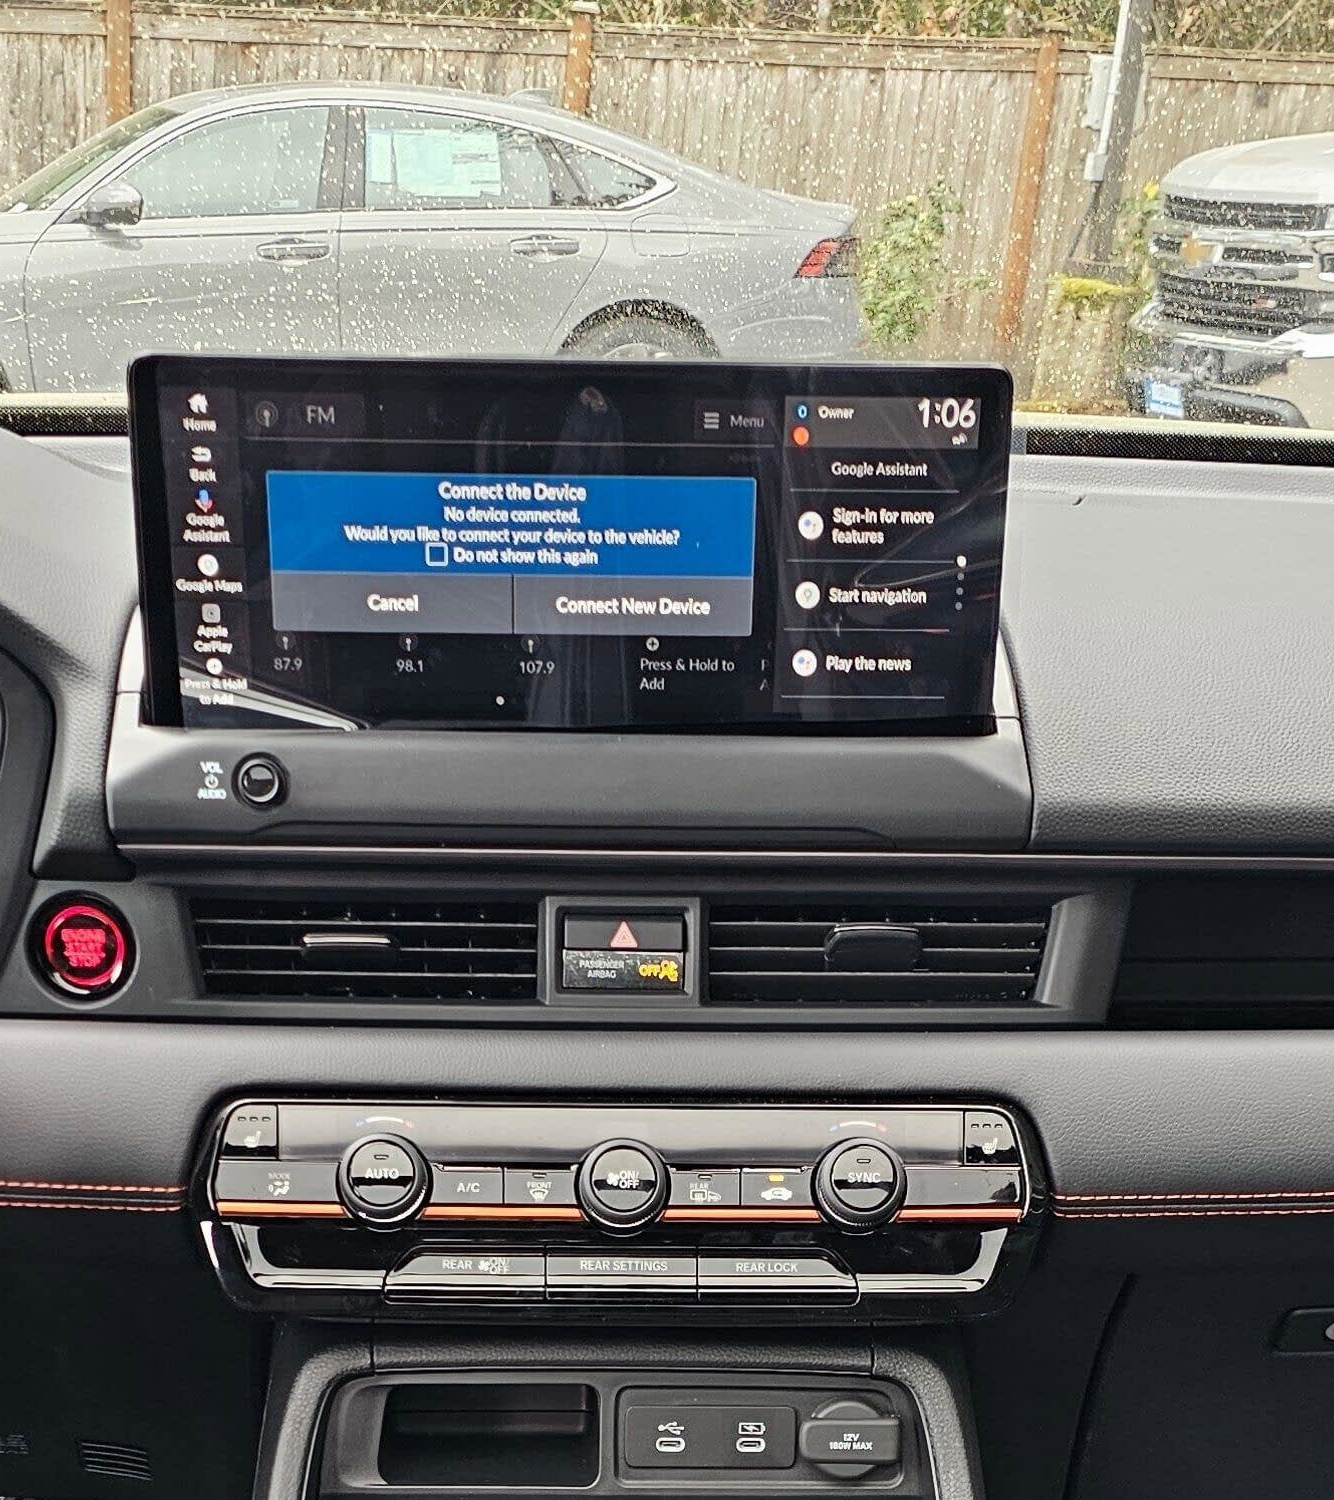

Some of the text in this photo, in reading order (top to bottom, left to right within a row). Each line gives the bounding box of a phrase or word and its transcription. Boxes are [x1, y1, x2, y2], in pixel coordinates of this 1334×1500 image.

[306, 405, 335, 424] FM
[818, 405, 854, 420] Owner
[918, 398, 976, 428] 1:06
[182, 417, 217, 432] Home
[730, 414, 764, 428] Menu
[188, 468, 217, 482] Back
[831, 461, 928, 478] Google Assistant
[438, 481, 587, 501] Connect the Device
[185, 513, 225, 528] Google
[443, 506, 581, 524] No device connected.
[832, 507, 935, 525] Sign-in for more
[343, 525, 680, 546] Would you like to connect your device to the vehicle?
[832, 528, 885, 545] features
[453, 547, 599, 567] Do not show this again
[367, 594, 419, 612] Cancel
[828, 588, 927, 606] Start navigation
[555, 596, 711, 616] Connect New Device
[273, 658, 303, 671] 87.9
[396, 659, 424, 673] 98.1
[519, 661, 556, 675] 107.9
[640, 658, 736, 672] Press & Hold to
[825, 654, 912, 674] Play the news
[639, 678, 665, 691] Add
[200, 761, 224, 774] VOL
[197, 788, 227, 800] AUDIO
[579, 959, 625, 970] PASSENGER
[587, 969, 617, 979] AIRBAG
[364, 1168, 400, 1180] AUTO
[847, 1172, 882, 1184] SYNC
[456, 1182, 480, 1193] A/C
[527, 1181, 552, 1190] FRONT
[619, 1180, 640, 1189] OFF
[690, 1182, 709, 1190] REAR
[442, 1259, 472, 1270] REAR
[490, 1265, 509, 1275] OFF
[579, 1260, 668, 1272] REAR SETTINGS
[735, 1262, 799, 1273] REAR LOCK
[843, 1433, 860, 1442] 12V
[852, 1441, 873, 1450] MAX
